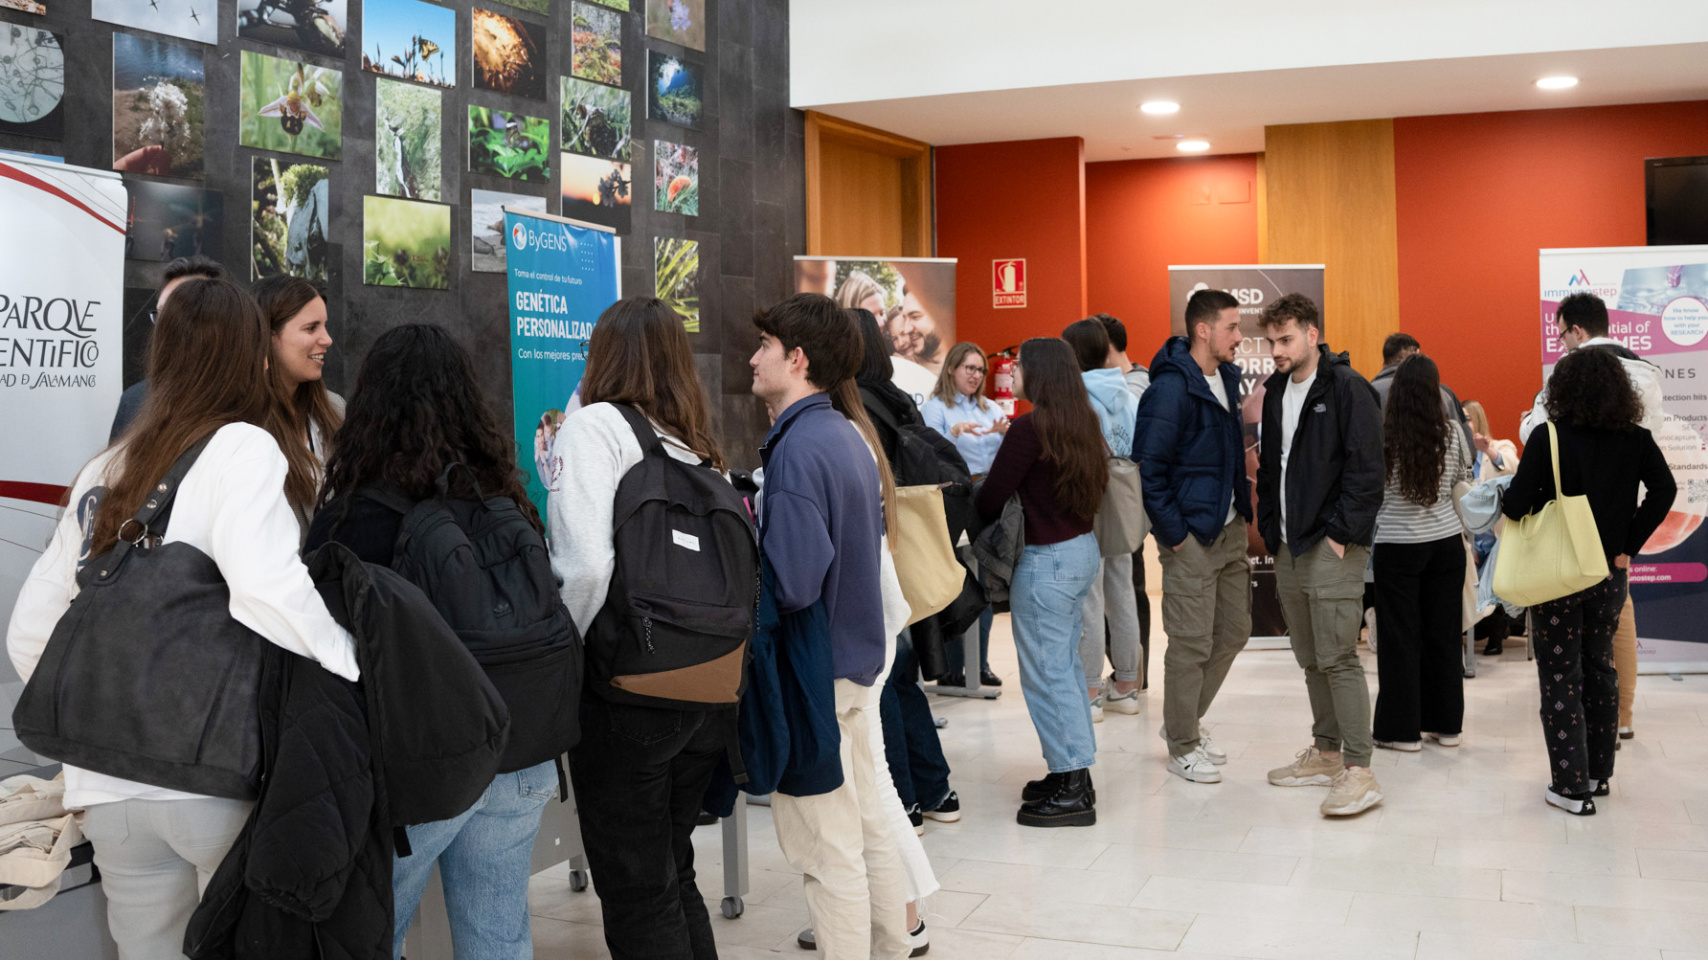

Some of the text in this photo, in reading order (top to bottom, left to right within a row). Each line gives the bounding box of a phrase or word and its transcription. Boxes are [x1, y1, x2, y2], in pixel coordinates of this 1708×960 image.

[528, 230, 567, 252] ByGENS
[514, 268, 529, 278] Toma
[530, 271, 535, 279] el
[536, 272, 554, 281] control
[554, 274, 561, 283] de
[516, 289, 568, 314] GENÉTICA
[996, 295, 1024, 304] EXTINTOR
[517, 317, 596, 340] PERSONALIZAD
[1545, 323, 1560, 336] th
[1635, 321, 1651, 333] of
[518, 348, 532, 359] Con
[533, 348, 543, 359] los
[543, 349, 571, 362] mejores
[1236, 357, 1276, 375] ORR
[1673, 414, 1708, 422] Products
